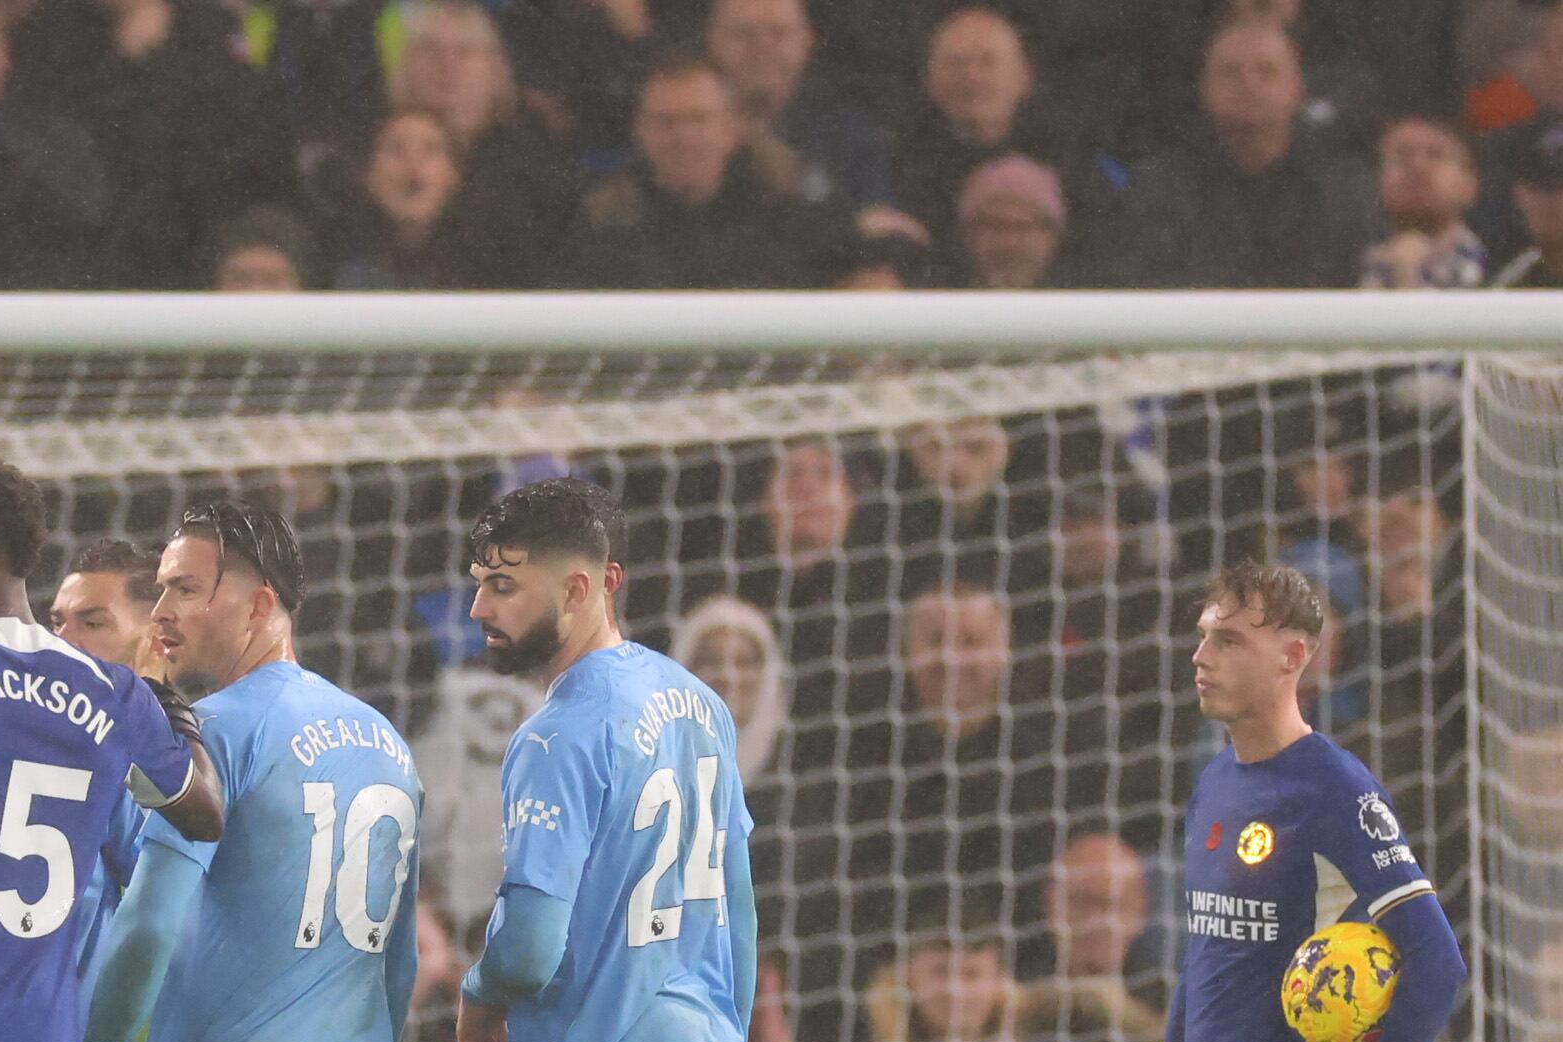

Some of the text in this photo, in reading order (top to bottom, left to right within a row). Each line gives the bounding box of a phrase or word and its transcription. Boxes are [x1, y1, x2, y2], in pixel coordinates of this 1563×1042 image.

[634, 687, 716, 756] GVARDIOL
[294, 782, 417, 954] 10
[628, 755, 728, 948] 24
[1372, 849, 1389, 862] No
[1192, 890, 1278, 920] INFINITE
